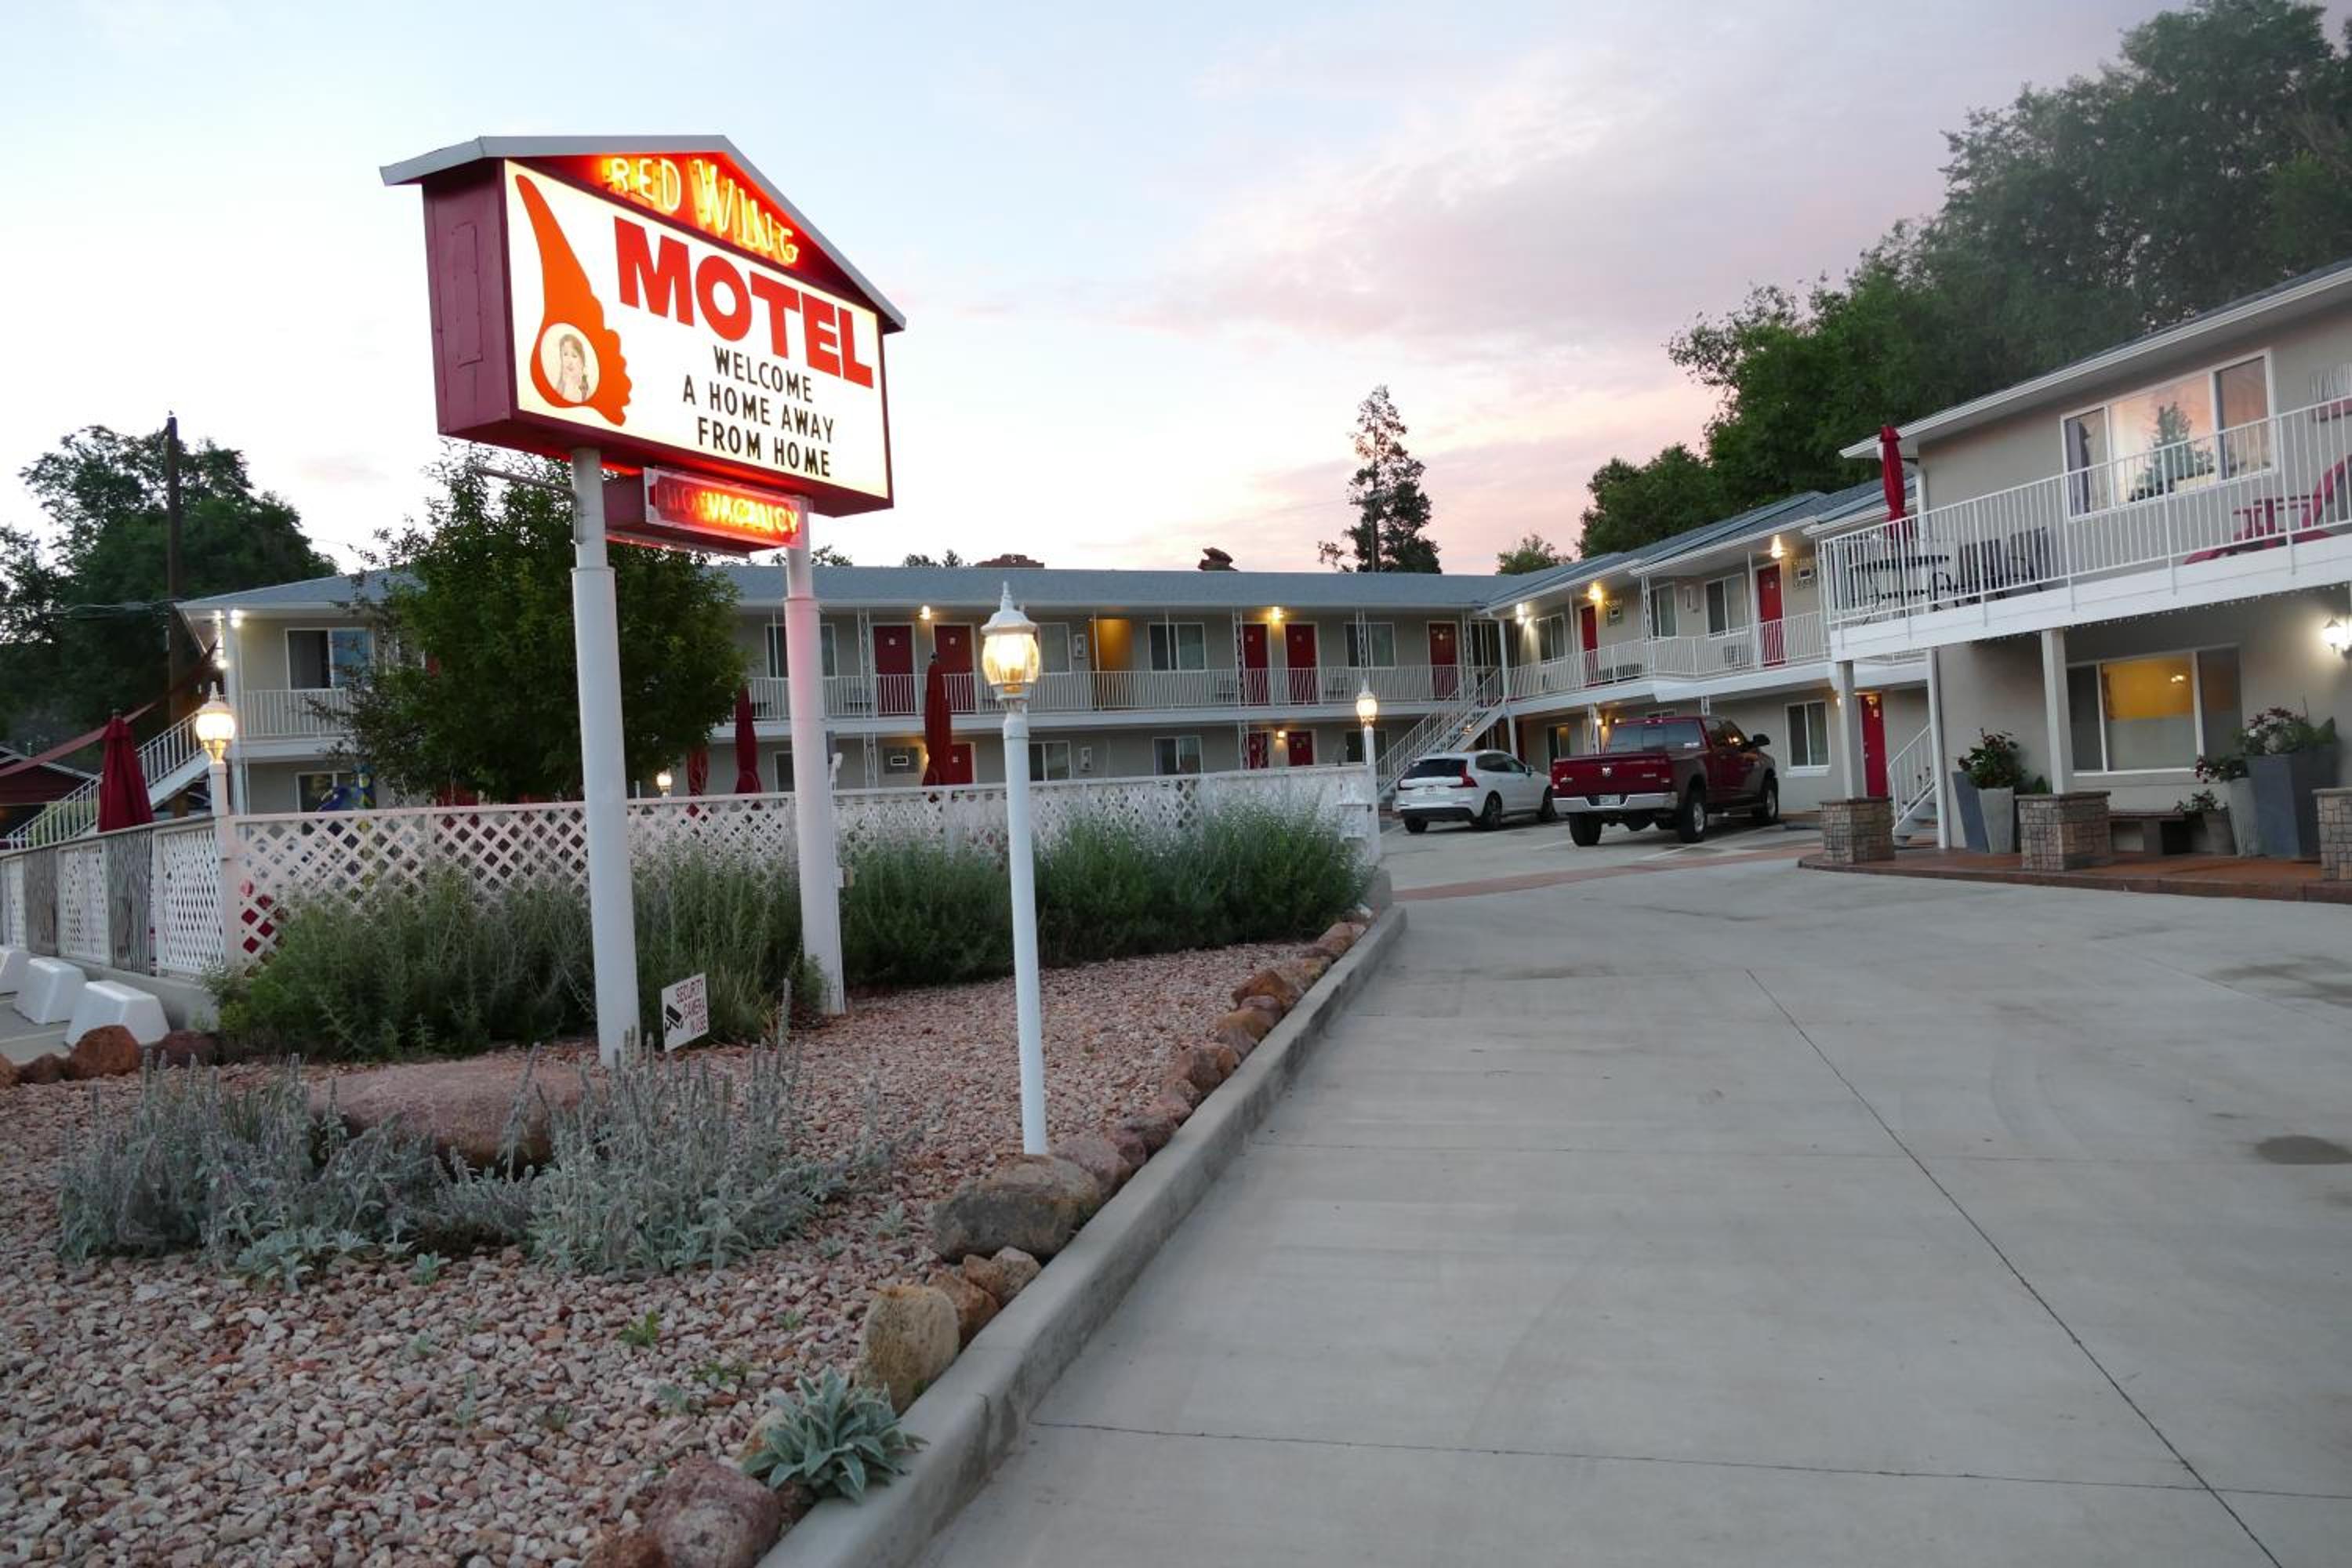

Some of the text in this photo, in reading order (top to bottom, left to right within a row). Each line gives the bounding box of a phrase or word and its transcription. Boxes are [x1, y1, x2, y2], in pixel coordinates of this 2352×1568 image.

[611, 157, 800, 263] RED WING
[614, 216, 873, 389] MOTEL
[713, 345, 813, 403] WELCOME
[683, 374, 833, 443] A HOME AWAY
[698, 416, 830, 477] FROM HOME
[702, 491, 798, 533] VACANCY
[676, 978, 704, 1004] SECURITY
